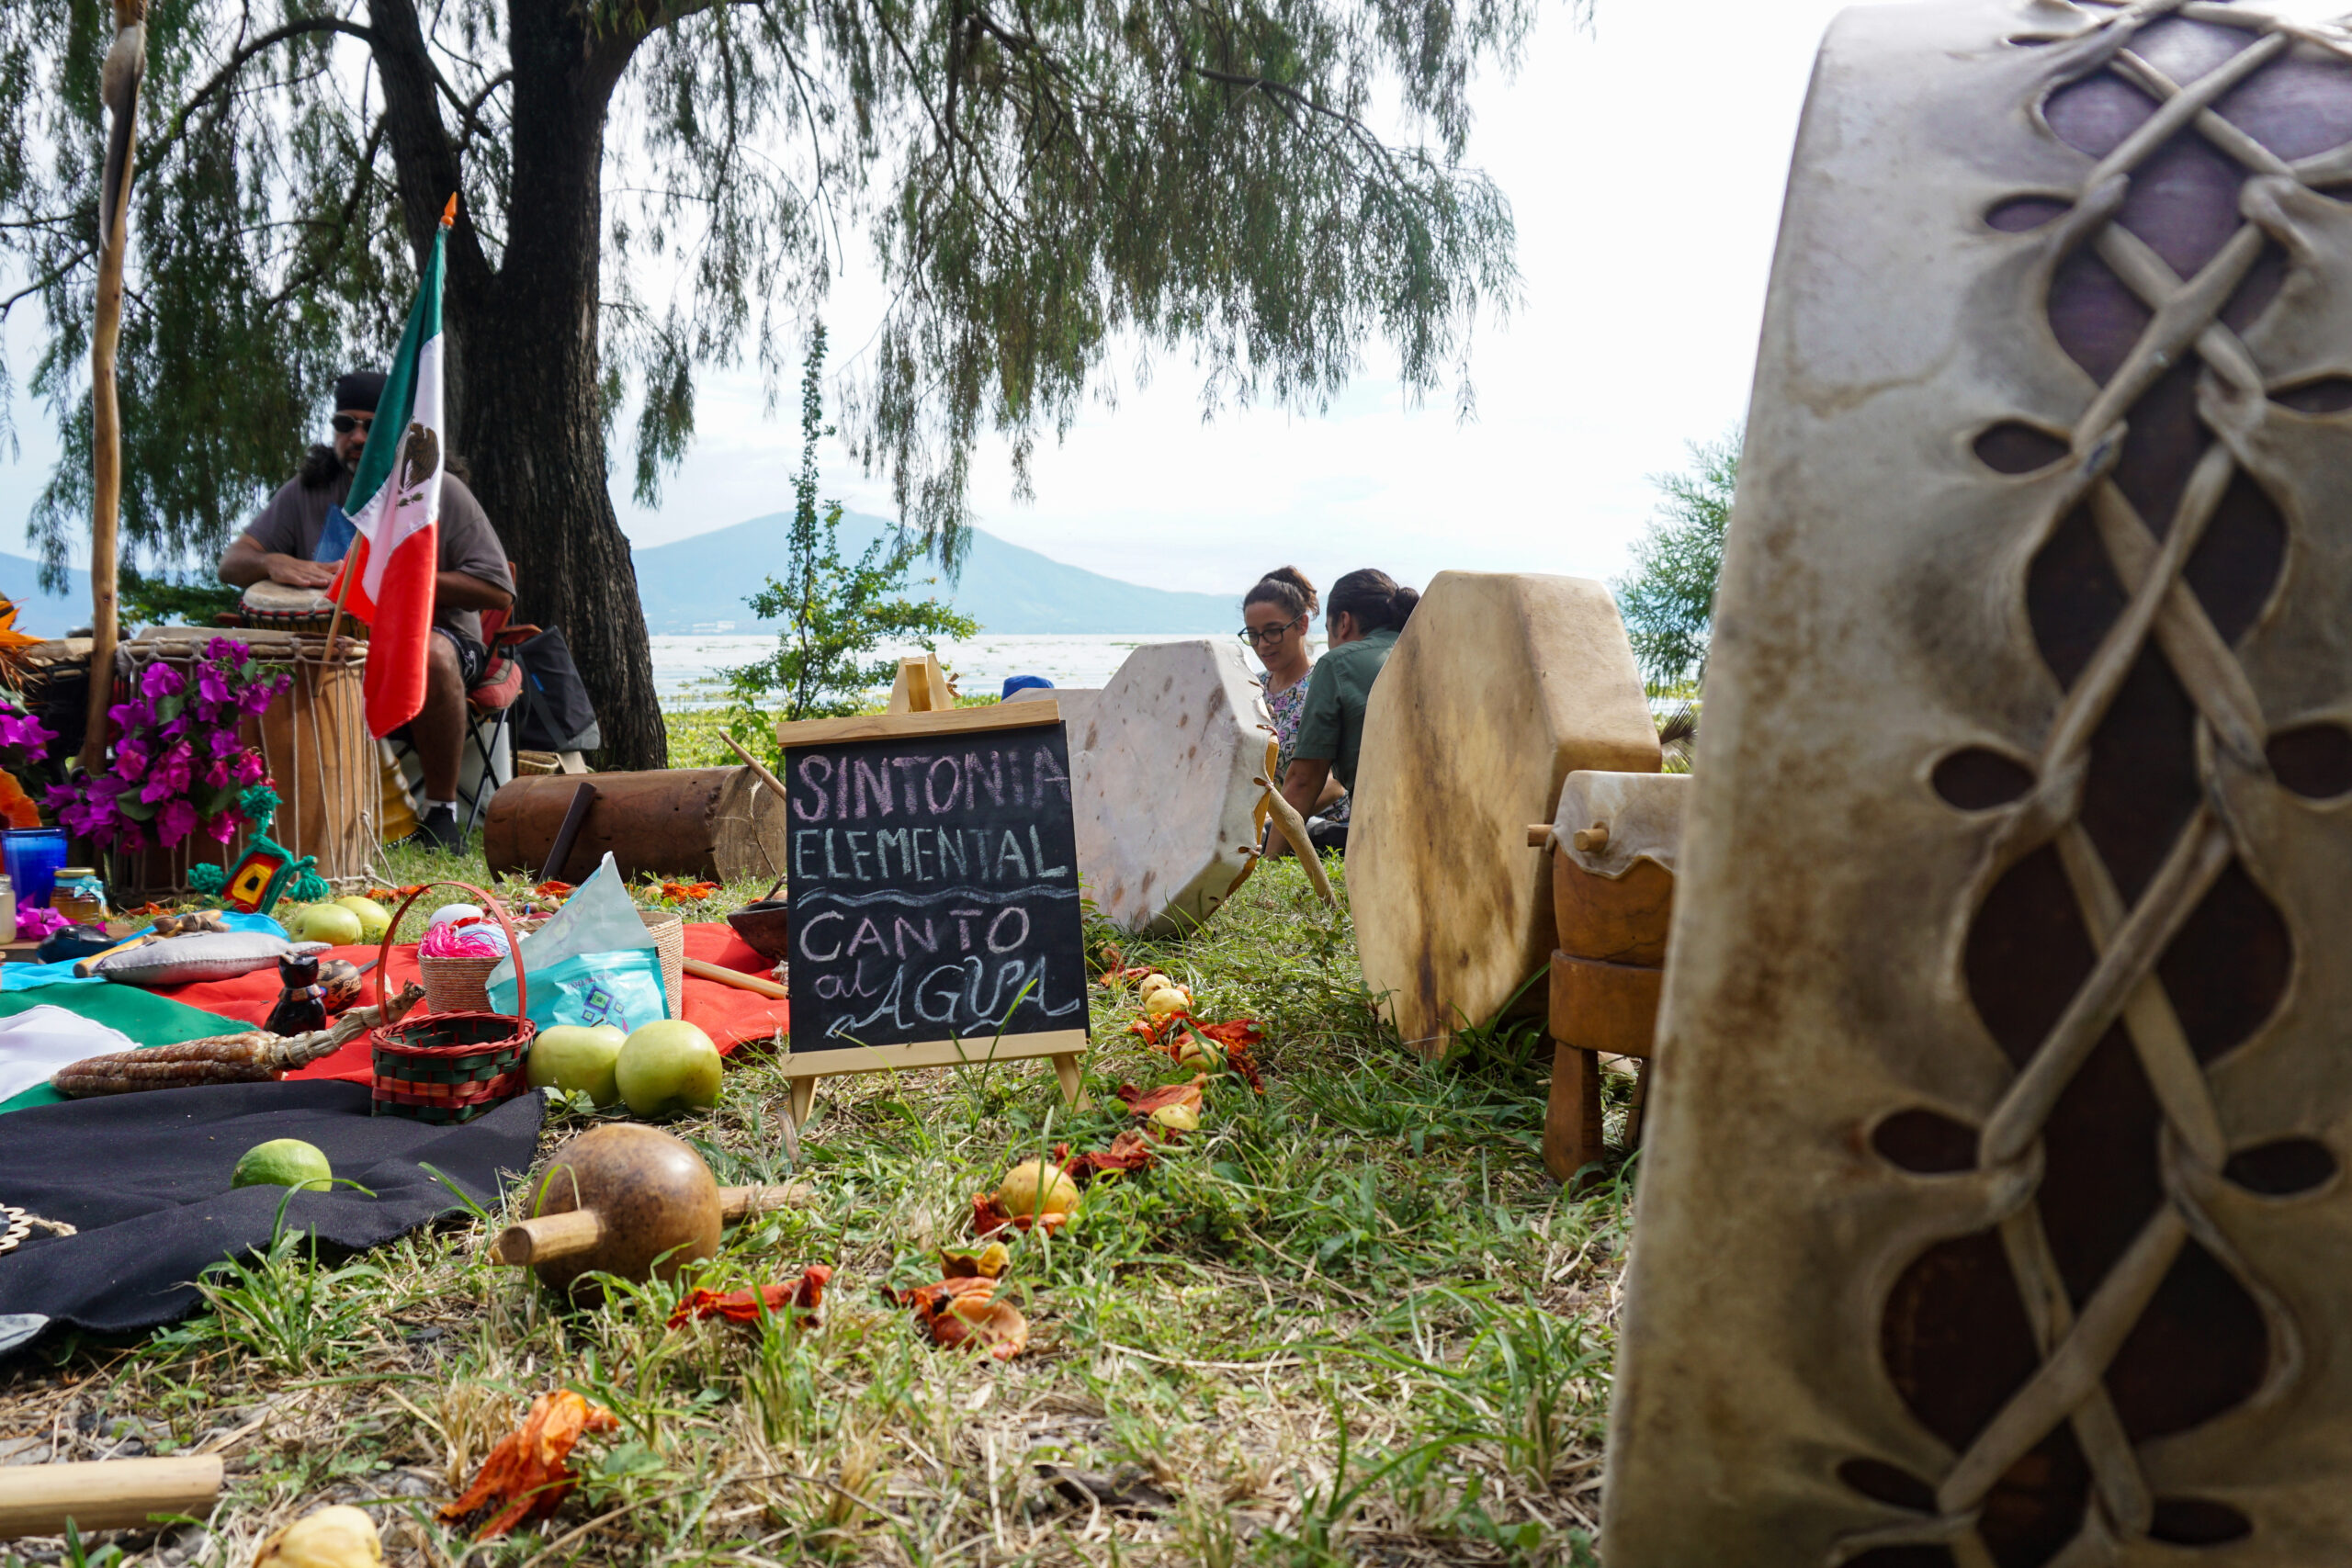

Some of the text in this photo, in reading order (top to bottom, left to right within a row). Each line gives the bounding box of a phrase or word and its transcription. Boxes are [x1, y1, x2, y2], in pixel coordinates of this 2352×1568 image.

[793, 744, 1071, 822] SINTONIA
[796, 825, 1068, 882] ELEMENTAL
[799, 907, 1029, 961] CANTO
[815, 955, 1080, 1038] al AGUA
